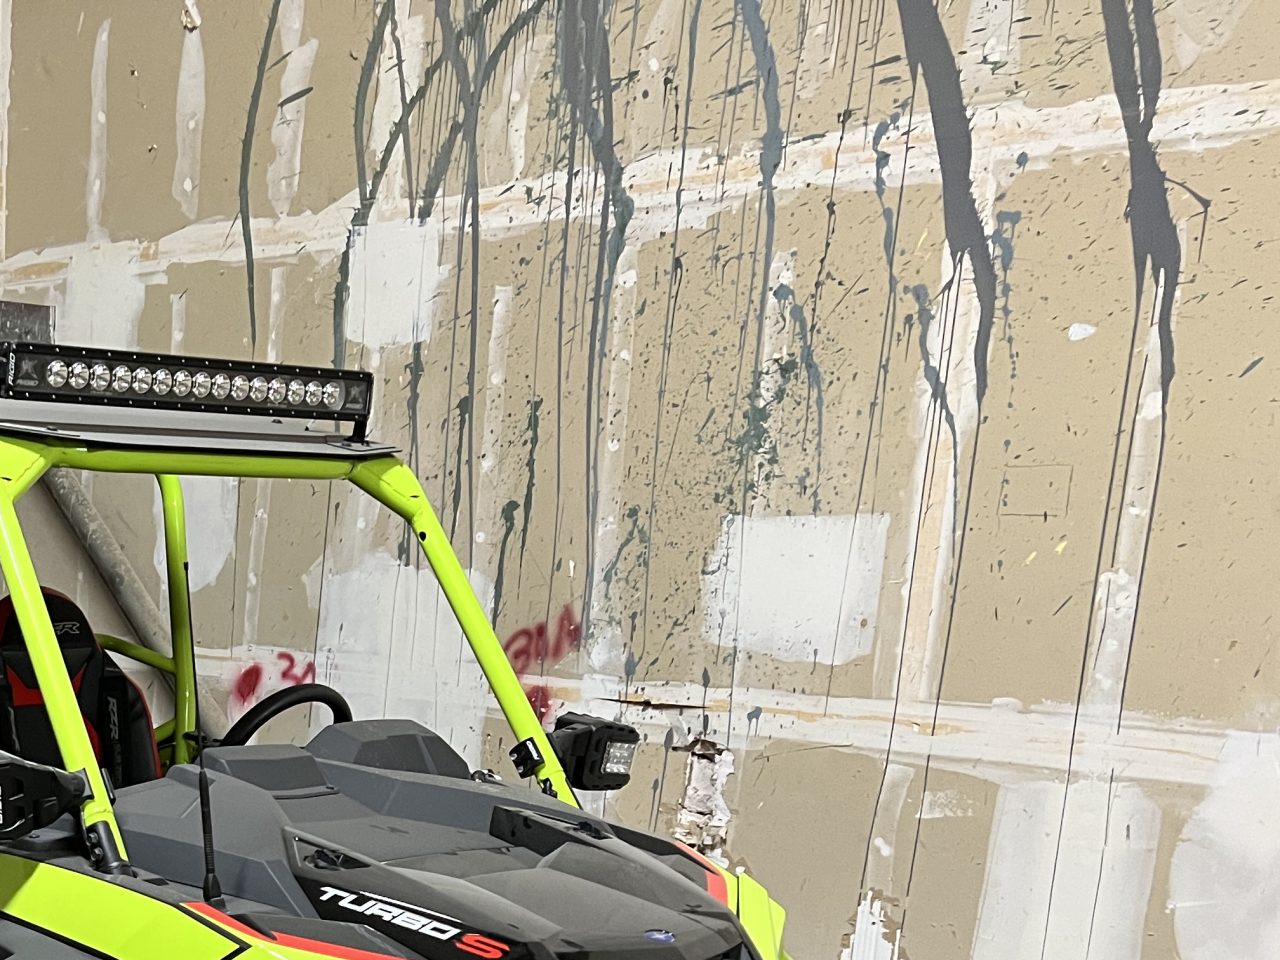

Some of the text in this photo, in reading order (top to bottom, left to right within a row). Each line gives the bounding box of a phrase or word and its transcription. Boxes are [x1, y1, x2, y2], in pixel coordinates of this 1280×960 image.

[107, 695, 120, 741] RZR
[320, 886, 511, 959] TURBO S
